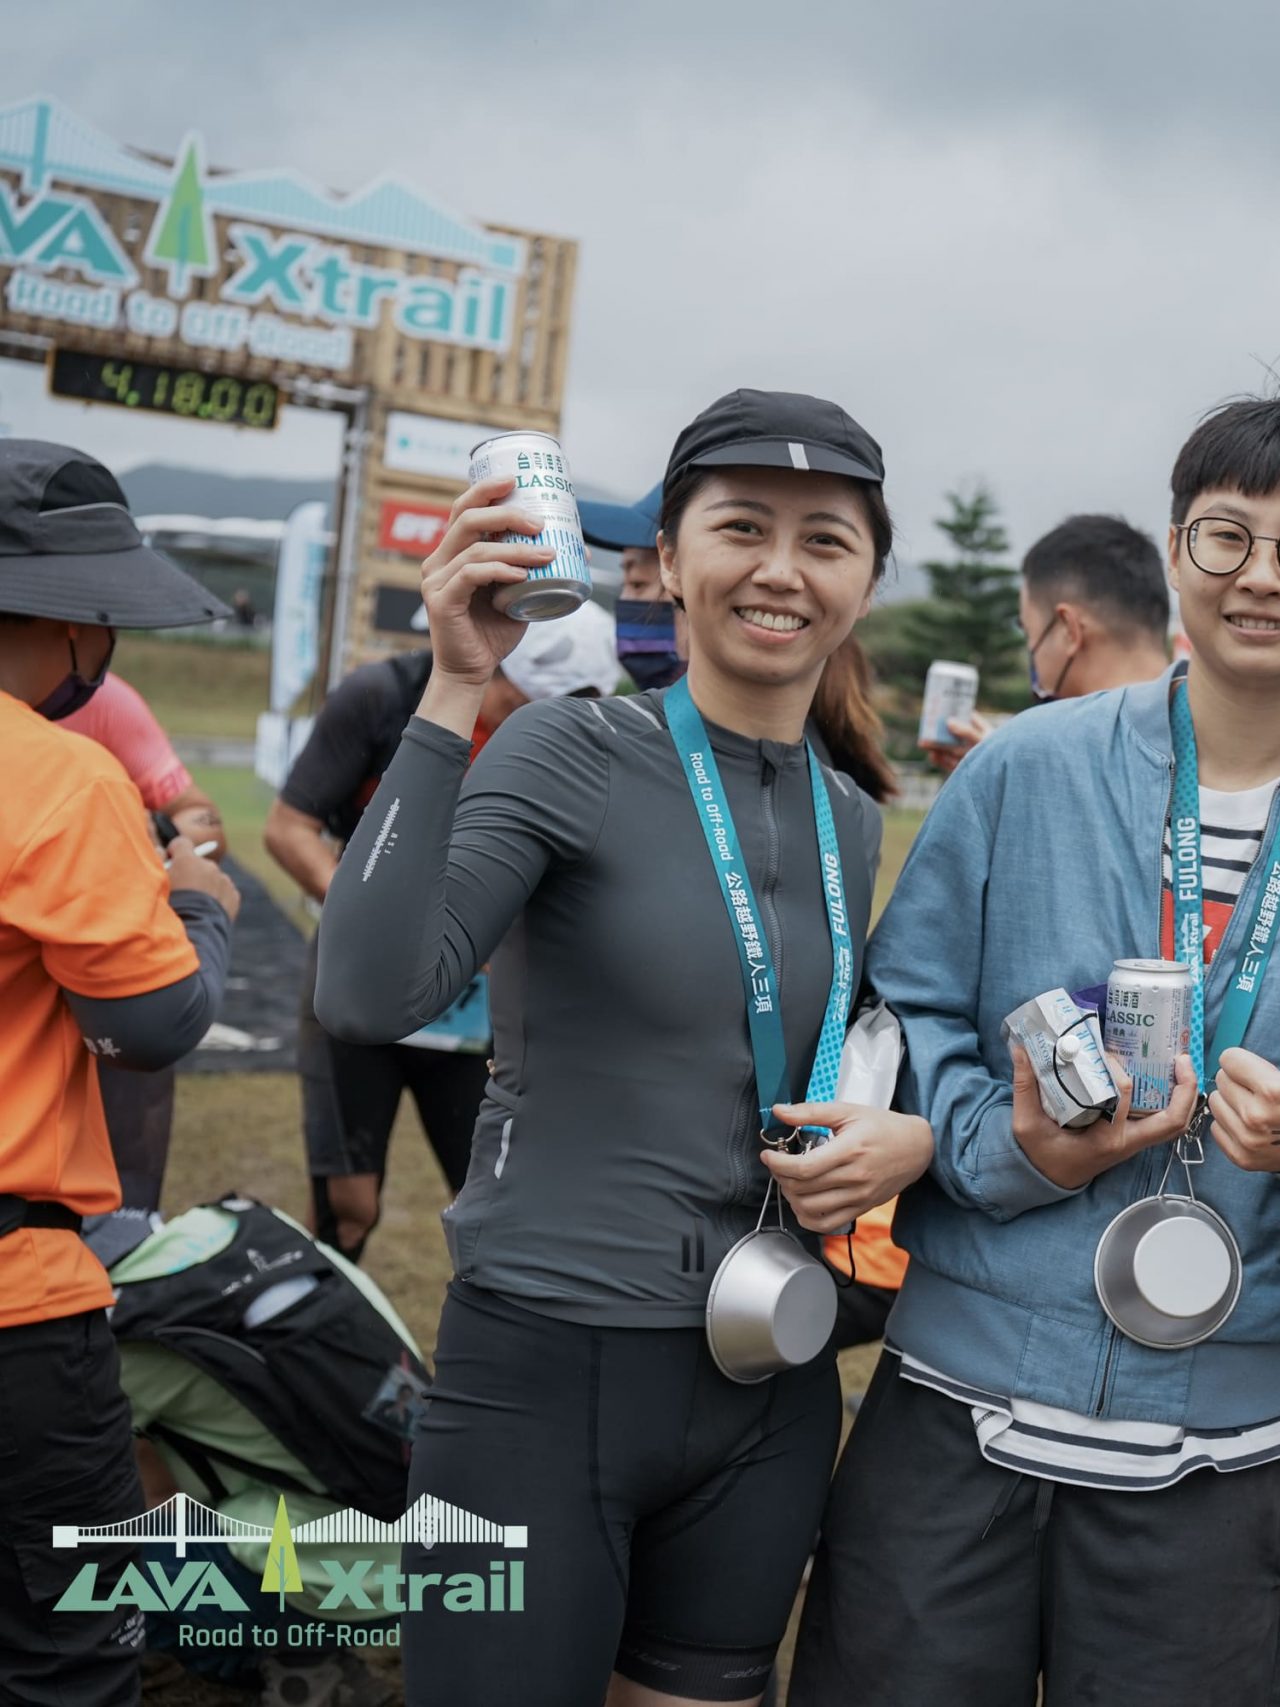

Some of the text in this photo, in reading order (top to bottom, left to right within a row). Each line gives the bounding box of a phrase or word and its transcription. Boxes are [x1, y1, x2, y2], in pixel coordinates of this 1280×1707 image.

[0, 188, 506, 342] VA Xtrail
[515, 474, 576, 498] LASSIC
[689, 752, 735, 861] Road to Off-Road
[824, 852, 848, 937] FULONG
[1178, 815, 1198, 901] FULONG
[724, 871, 774, 1014] 公路越野鐵人三項
[1189, 912, 1199, 945] Xtrail
